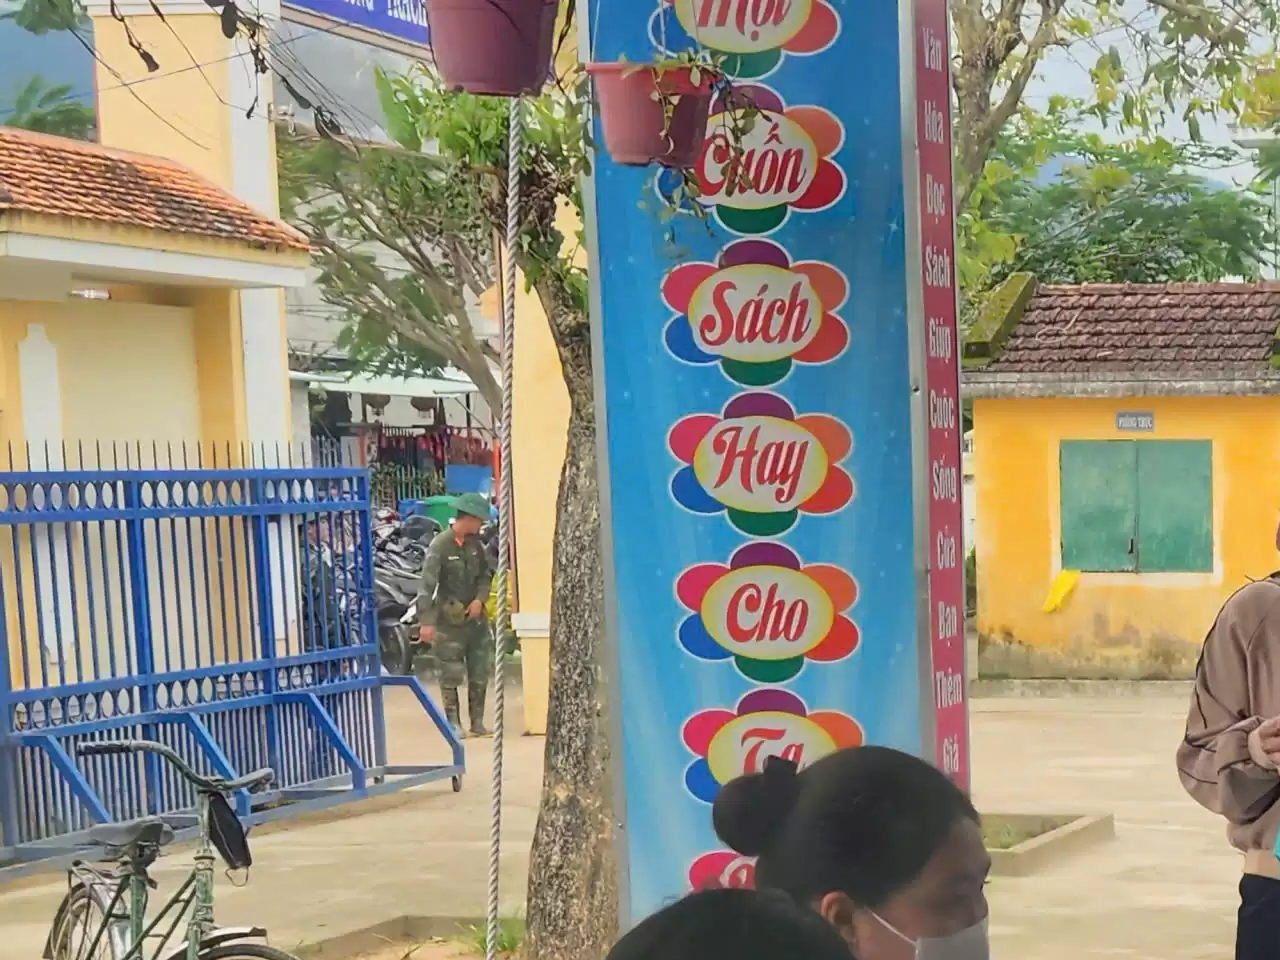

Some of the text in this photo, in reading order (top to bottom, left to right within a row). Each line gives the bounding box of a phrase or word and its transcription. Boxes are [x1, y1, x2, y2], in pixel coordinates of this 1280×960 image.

[924, 100, 944, 145] Hóa
[695, 122, 807, 196] Cuốn
[925, 246, 950, 288] Sách
[700, 279, 812, 346] Sách
[929, 317, 952, 364] Giúp
[930, 388, 954, 438] Cuộc
[712, 425, 809, 503] Hay
[932, 453, 957, 503] Sống
[725, 582, 809, 643] Cho
[937, 601, 957, 647] Bạn
[935, 666, 963, 710] Thêm
[943, 733, 960, 774] Giá
